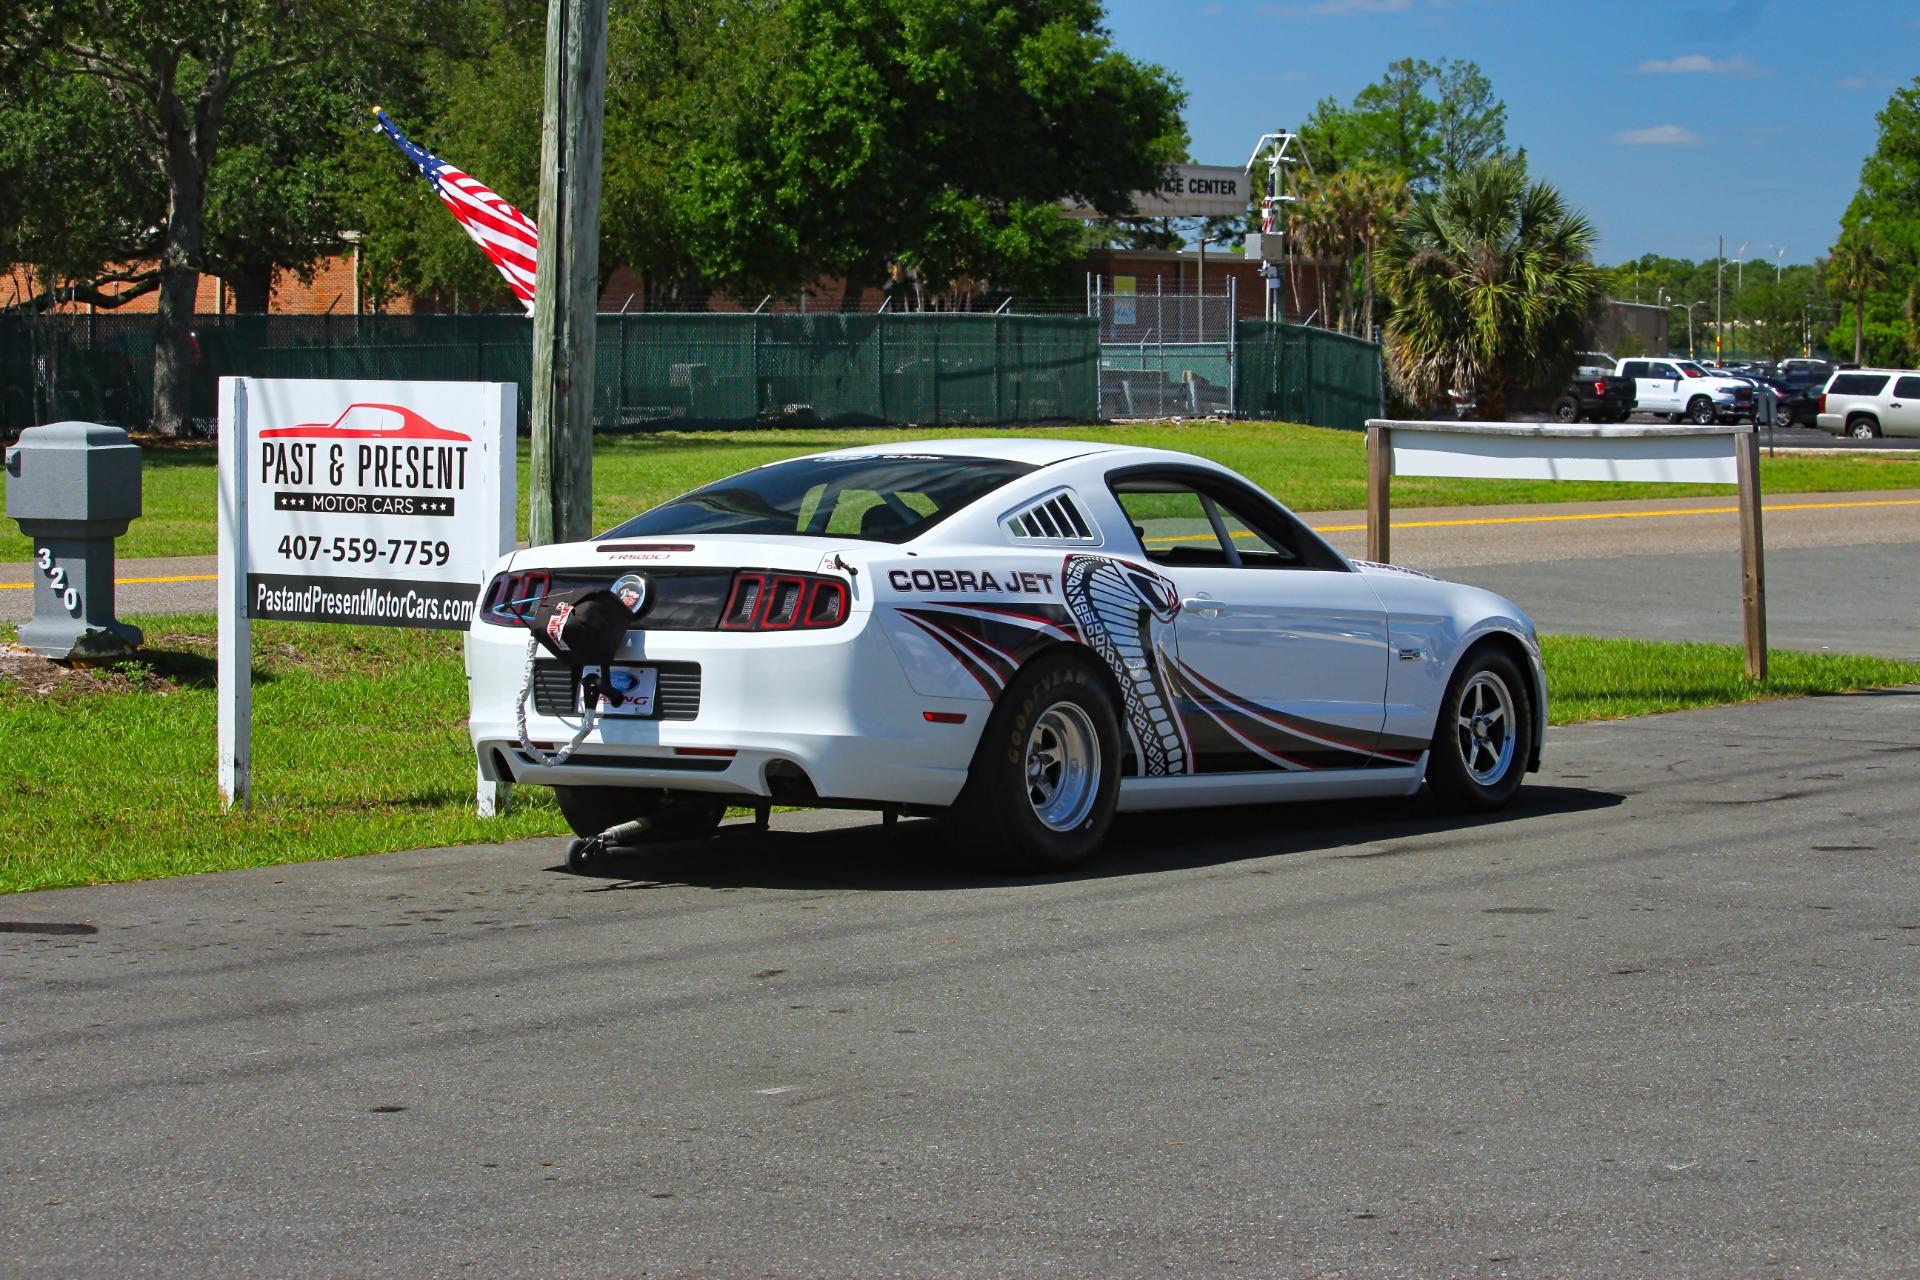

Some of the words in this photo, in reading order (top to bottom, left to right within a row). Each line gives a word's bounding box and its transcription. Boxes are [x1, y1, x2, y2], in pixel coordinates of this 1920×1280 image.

[1189, 178, 1237, 195] CENTER
[262, 442, 317, 485] PAST
[329, 443, 345, 487] &
[358, 444, 468, 490] PRESENT
[312, 495, 367, 513] MOTOR
[371, 497, 414, 514] CARS
[277, 534, 450, 566] 407-559-7759
[888, 569, 1004, 593] COBRA
[1004, 570, 1054, 595] JET
[256, 583, 474, 622] PastandPresentMotorCars.com
